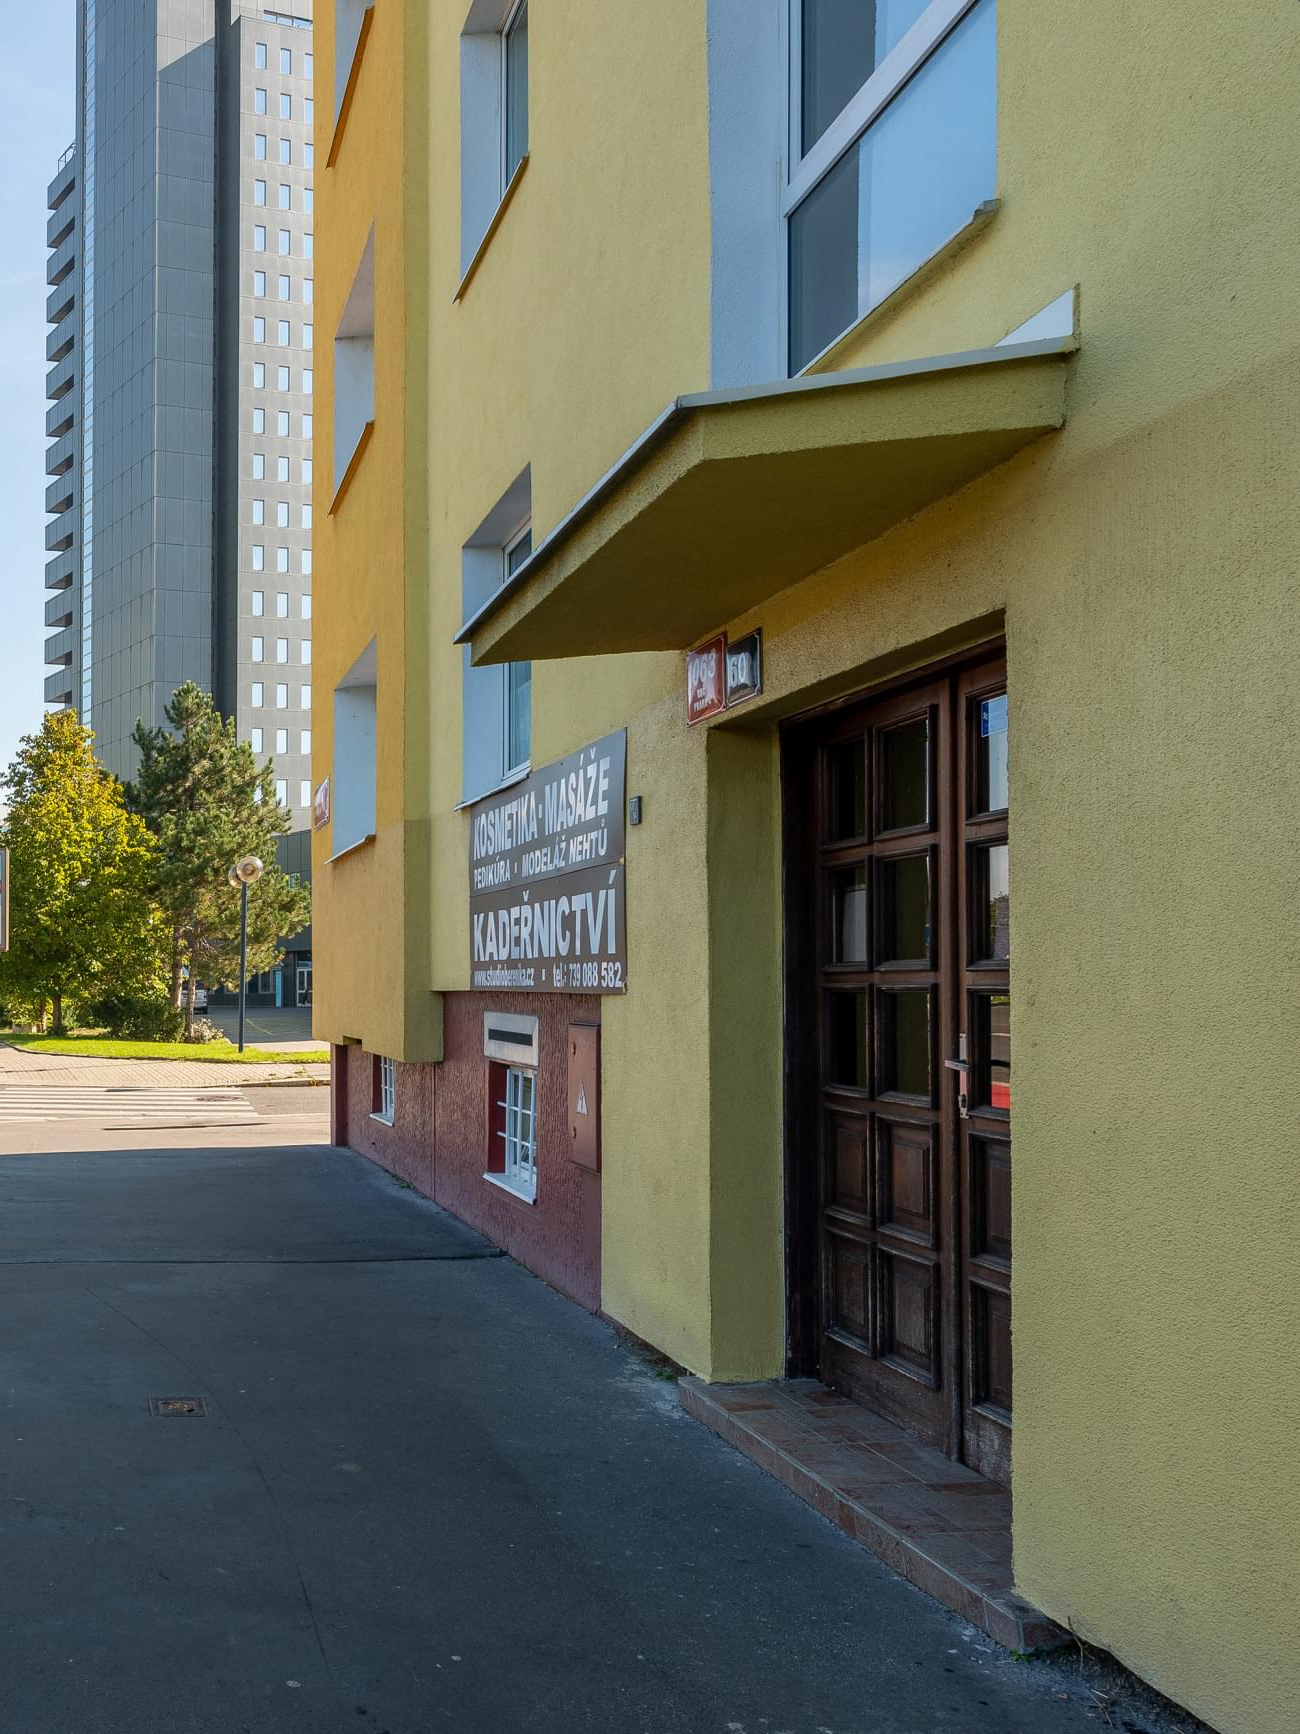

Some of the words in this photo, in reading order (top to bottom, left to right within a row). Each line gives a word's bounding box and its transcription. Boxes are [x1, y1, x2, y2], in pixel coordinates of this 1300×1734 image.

[473, 791, 537, 860] KOSMETIKA
[545, 747, 611, 833] MASÁŽE
[474, 853, 511, 890] PEDIKÚRA
[522, 836, 566, 876] MODELÁŽ
[569, 820, 607, 863] NEHTŮ
[473, 870, 617, 961] KADEŘNICTVÍ
[569, 963, 581, 987] 739
[582, 962, 598, 987] 088
[601, 962, 622, 988] 582
